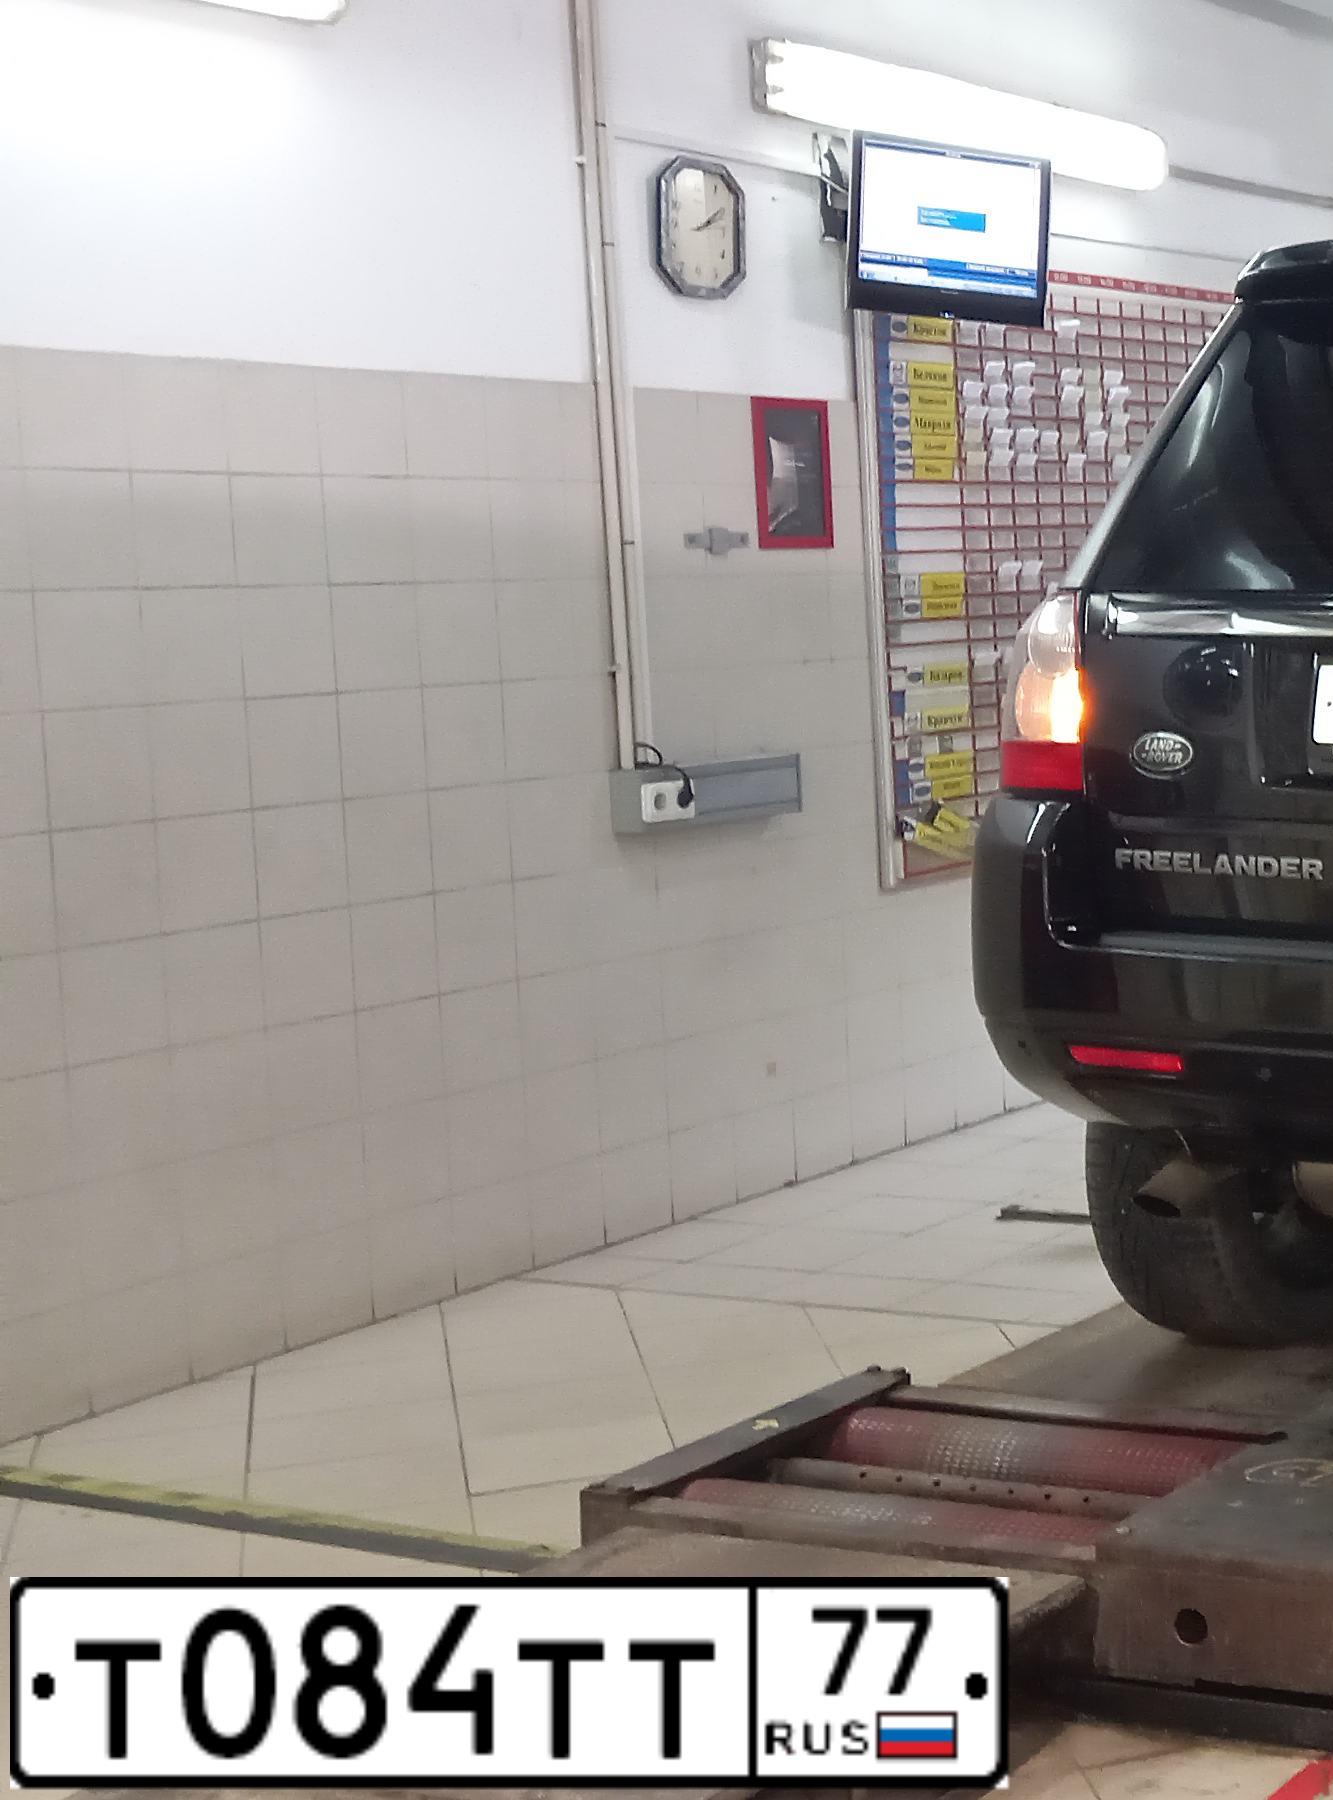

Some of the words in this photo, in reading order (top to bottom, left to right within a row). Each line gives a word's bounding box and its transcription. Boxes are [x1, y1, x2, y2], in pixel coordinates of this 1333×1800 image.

[1145, 738, 1174, 751] LAND
[1147, 750, 1183, 764] ROVER
[1114, 848, 1324, 881] FREELANDER
